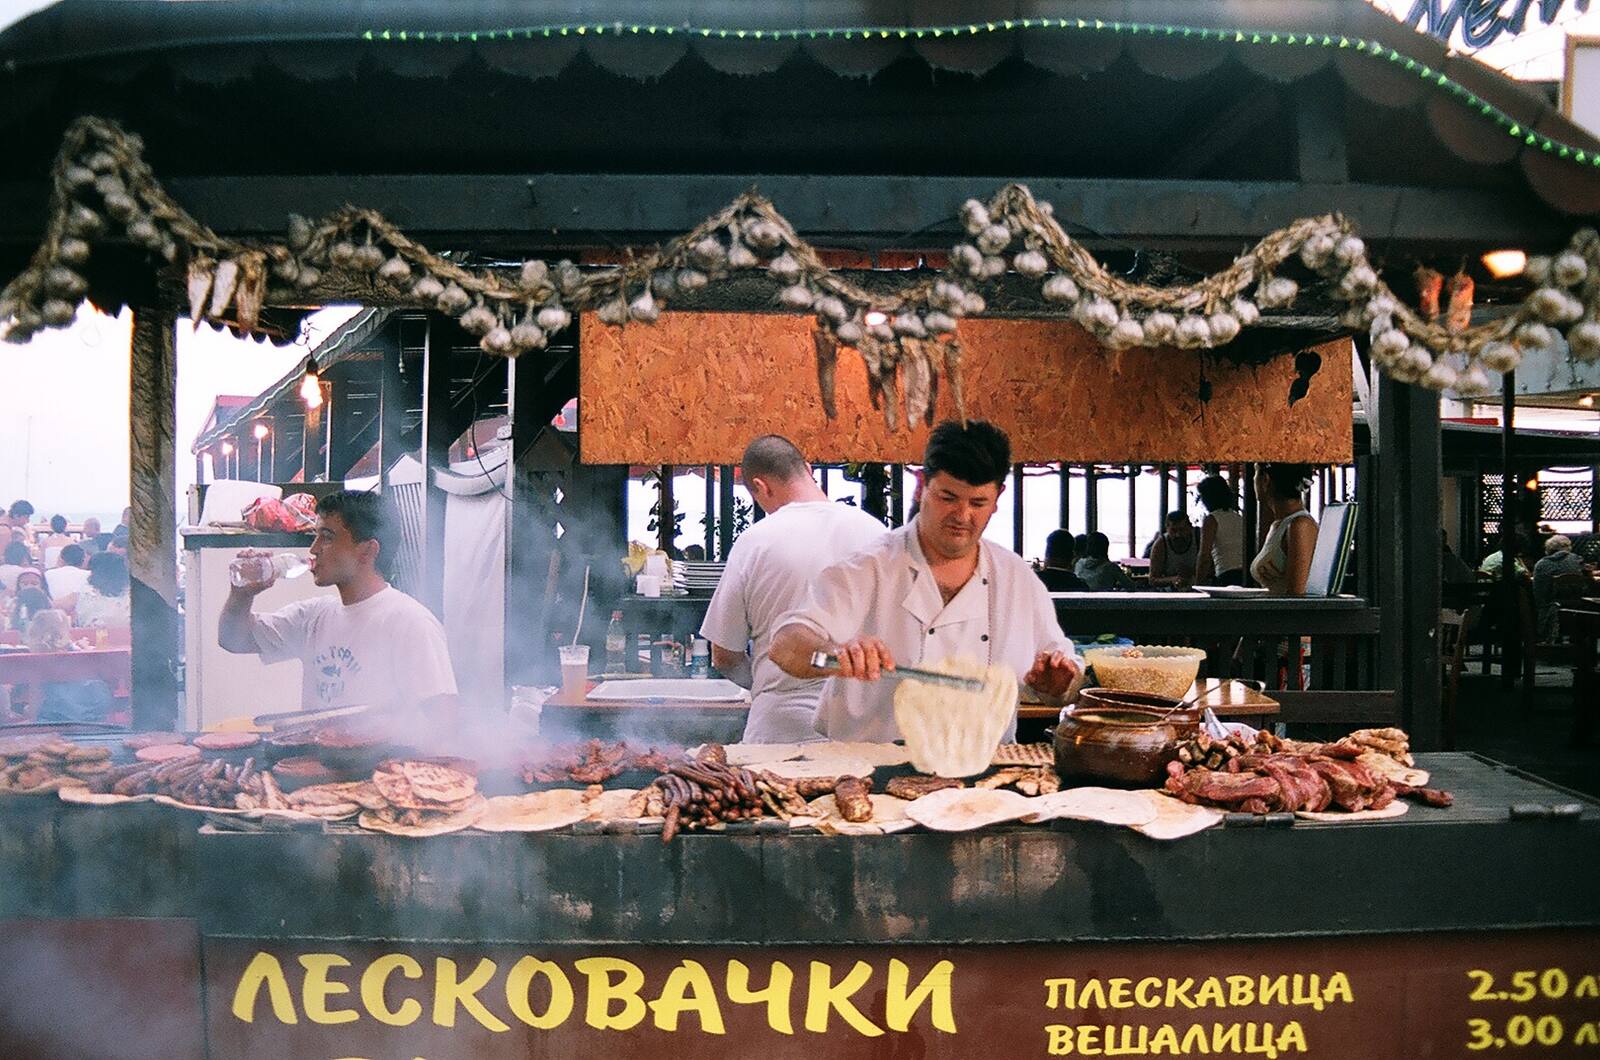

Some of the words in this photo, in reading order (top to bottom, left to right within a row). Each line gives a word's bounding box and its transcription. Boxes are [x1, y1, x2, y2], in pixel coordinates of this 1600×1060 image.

[231, 952, 959, 1038] ЛЕСКОВАЧКИ
[1044, 972, 1355, 1013] ПЛЕСКАВИЦА
[1466, 968, 1571, 1003] 2.50
[1574, 974, 1600, 999] л
[1044, 1021, 1309, 1059] ВЕШАЛИЦА
[1466, 1015, 1565, 1052] 3.00
[1574, 1022, 1600, 1046] л
